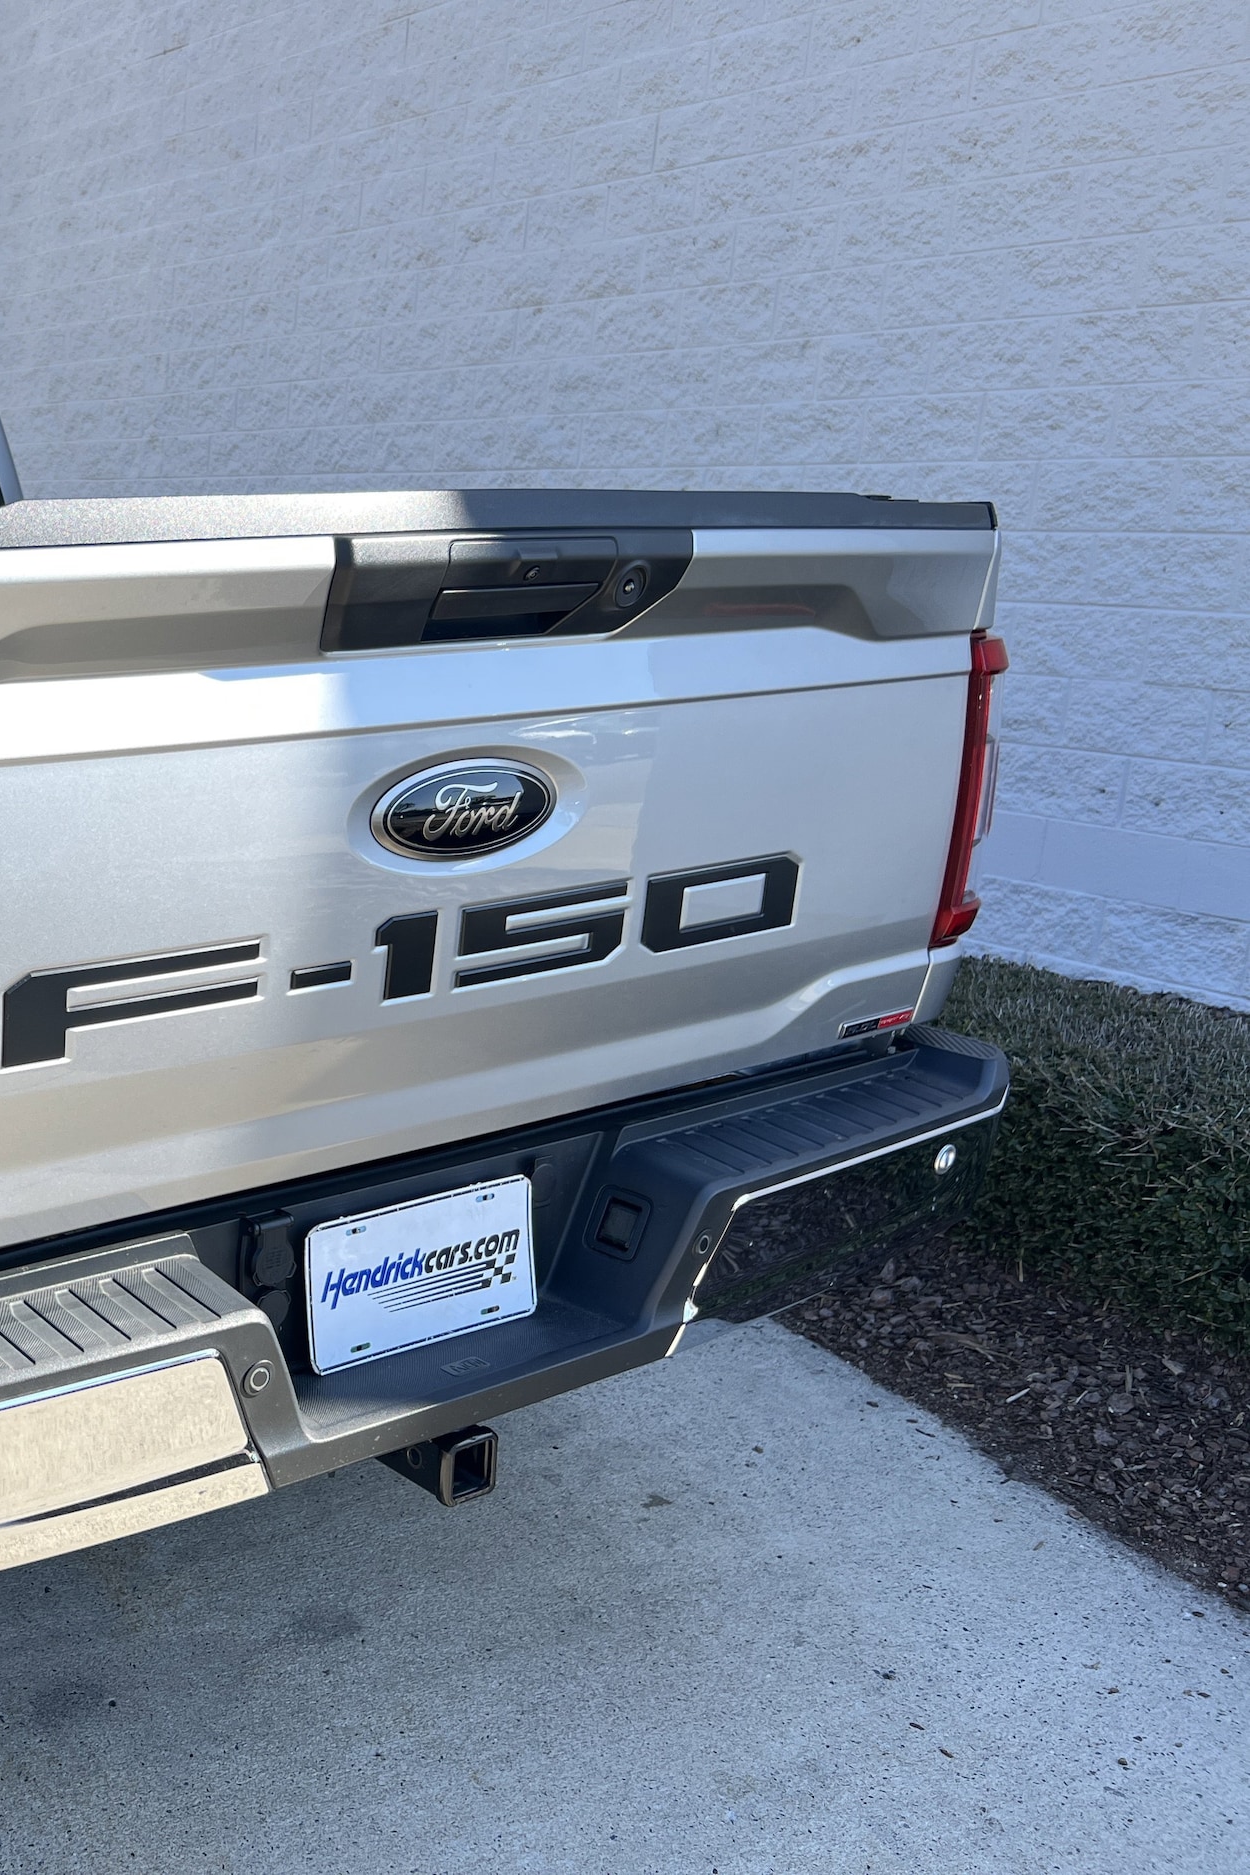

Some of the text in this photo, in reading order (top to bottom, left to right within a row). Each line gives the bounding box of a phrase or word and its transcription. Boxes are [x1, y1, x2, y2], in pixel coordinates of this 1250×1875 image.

[422, 781, 525, 842] Ford
[0, 851, 801, 1068] F-150
[320, 1227, 521, 1310] Hendrickcars.com
